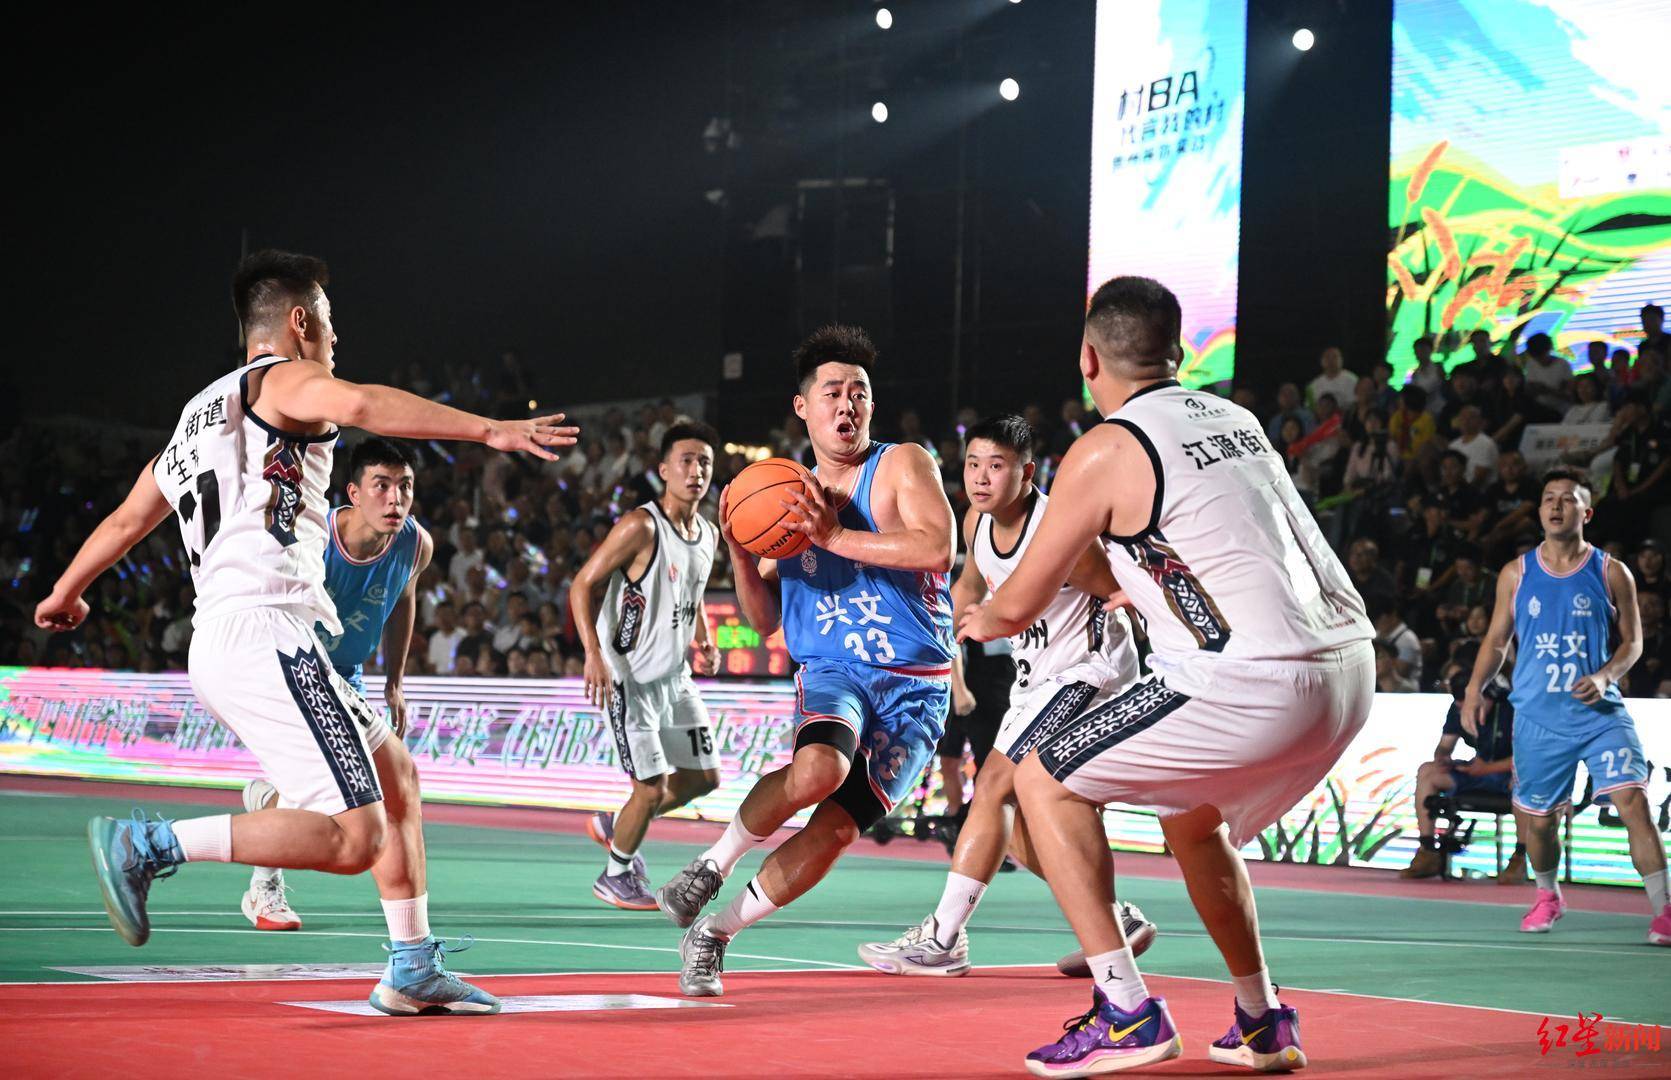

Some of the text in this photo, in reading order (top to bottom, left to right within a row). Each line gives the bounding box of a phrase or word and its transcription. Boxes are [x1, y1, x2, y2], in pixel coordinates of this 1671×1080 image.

[1182, 428, 1267, 470] 江源街
[755, 520, 799, 557] LI-NIN
[816, 590, 892, 635] 兴文
[844, 627, 896, 664] 33
[1535, 631, 1587, 659] 兴文
[1546, 663, 1577, 693] 22
[687, 727, 714, 757] 15
[1601, 747, 1636, 778] 22
